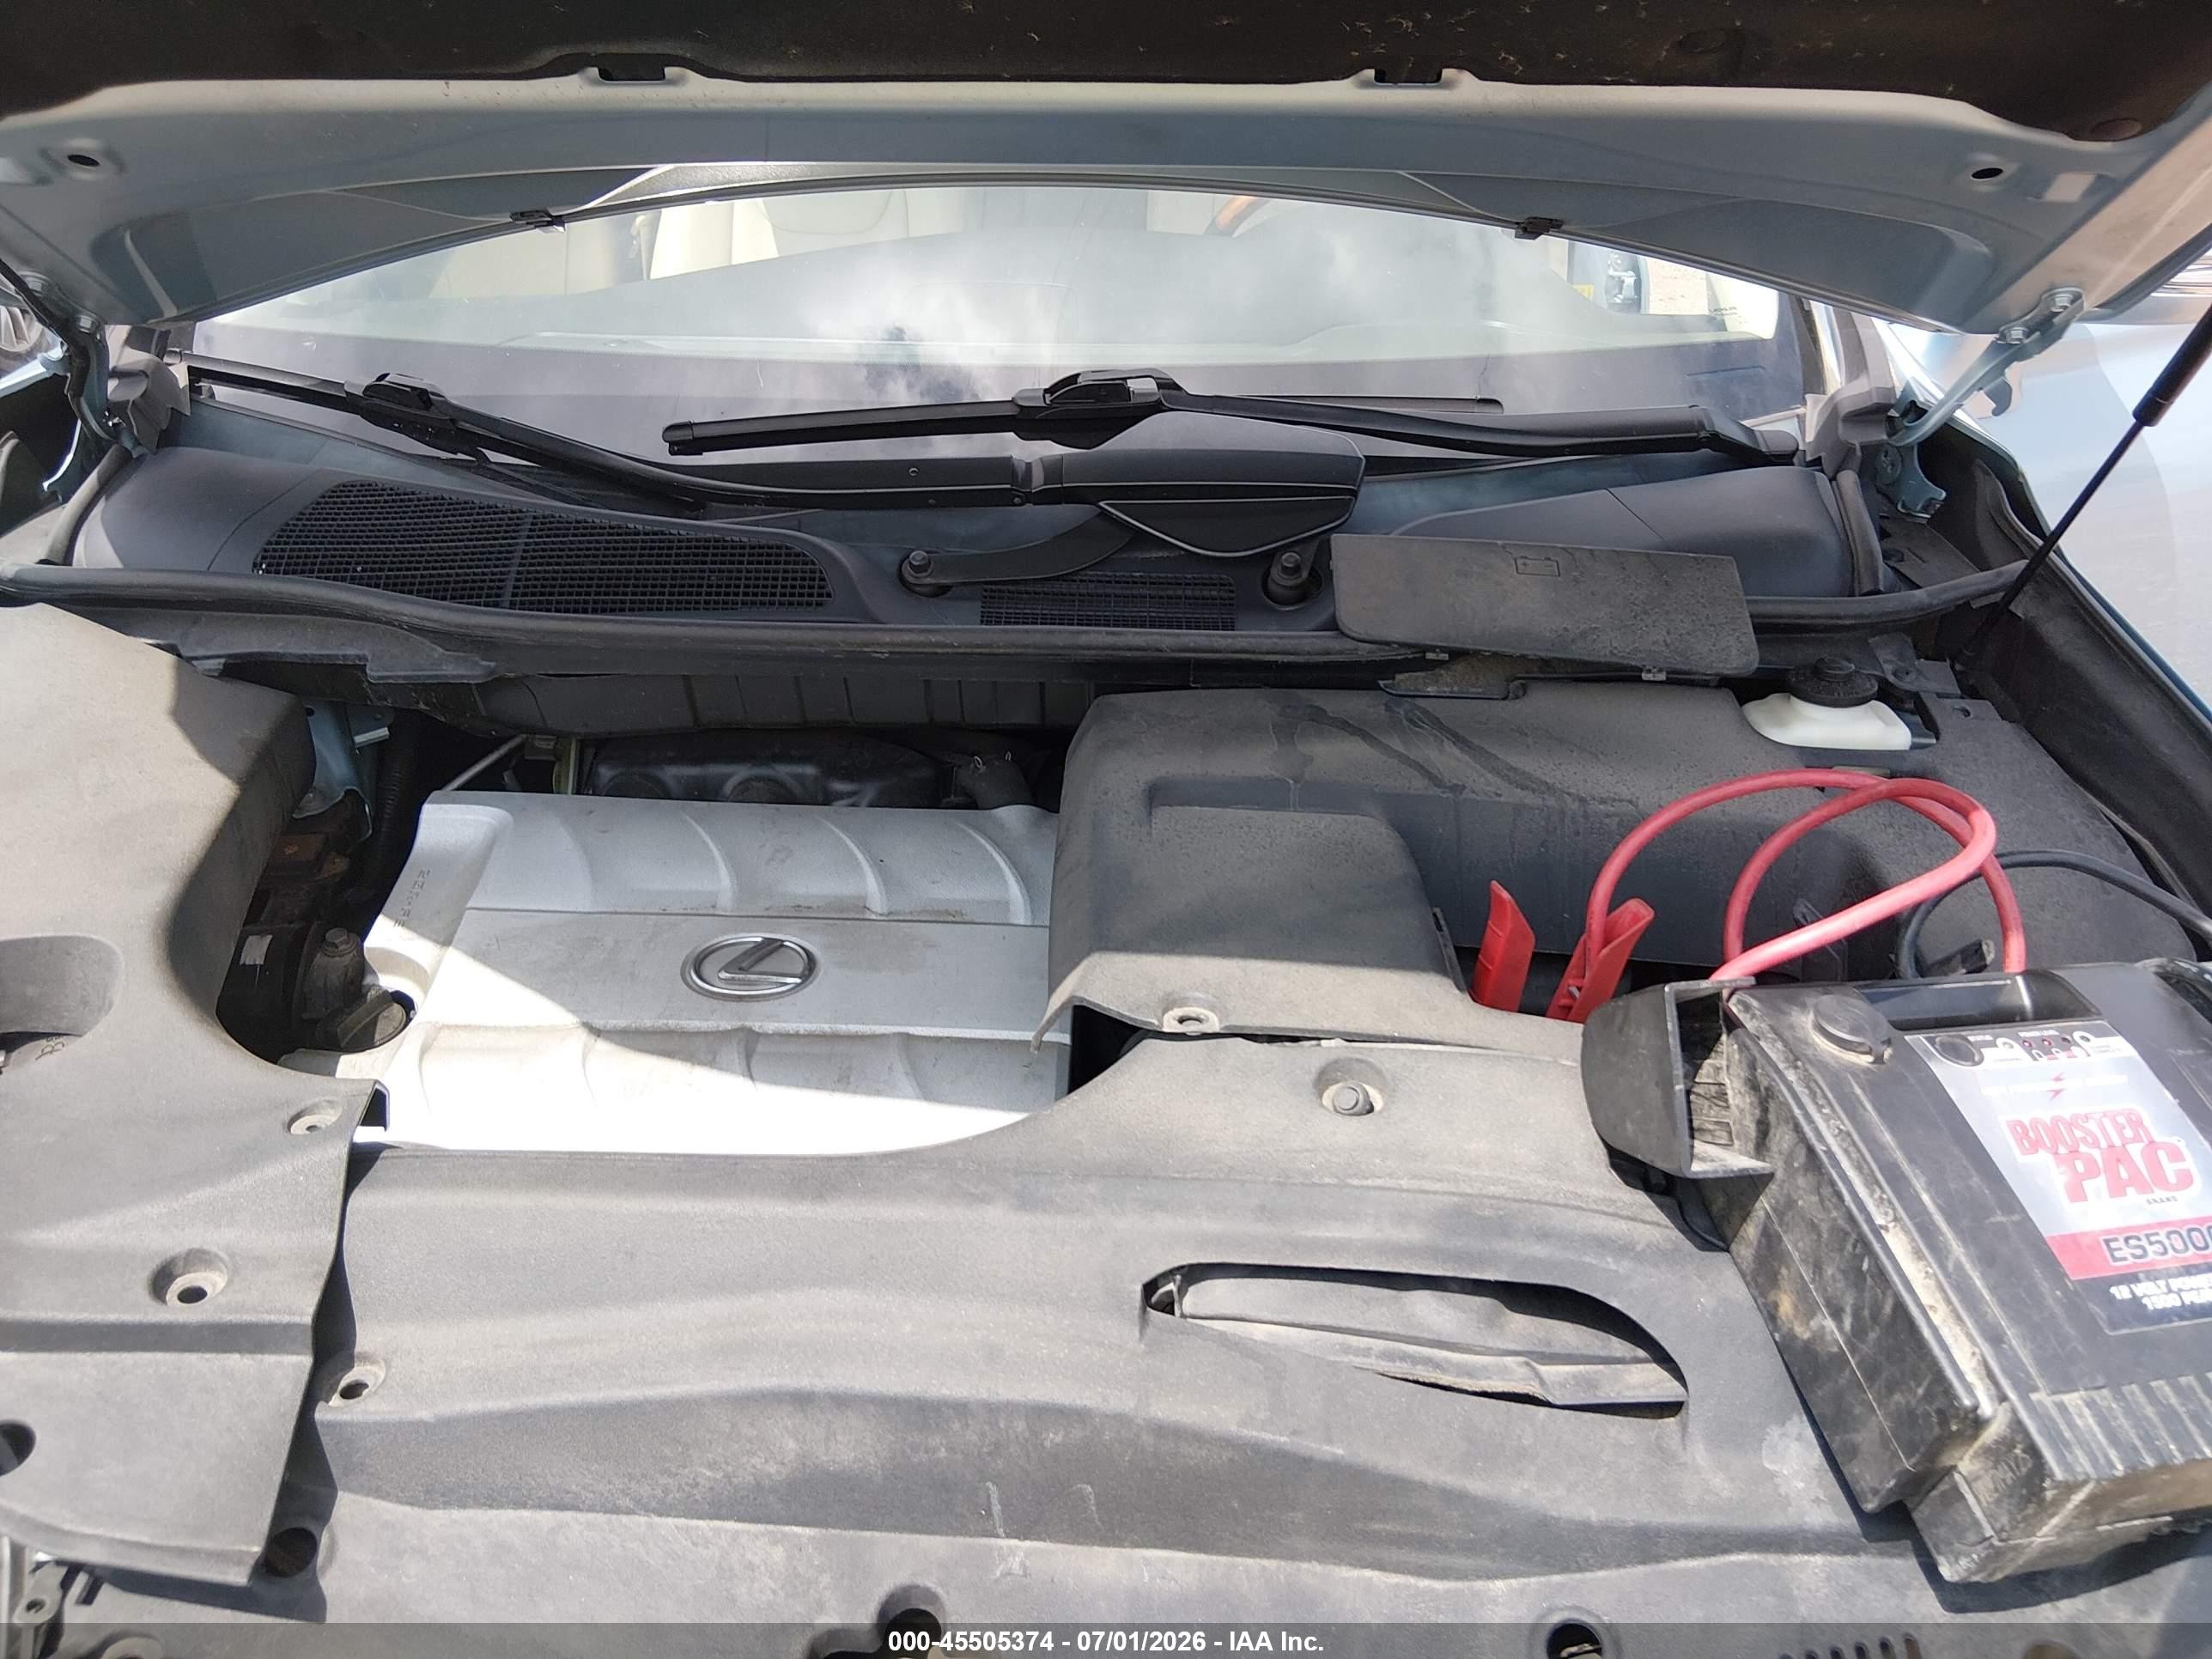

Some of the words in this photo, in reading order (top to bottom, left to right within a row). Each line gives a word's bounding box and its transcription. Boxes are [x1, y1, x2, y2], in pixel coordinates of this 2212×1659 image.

[2006, 1109, 2155, 1156] BOOSTER
[2053, 1141, 2193, 1203] PAC
[2103, 1224, 2212, 1263] ES500
